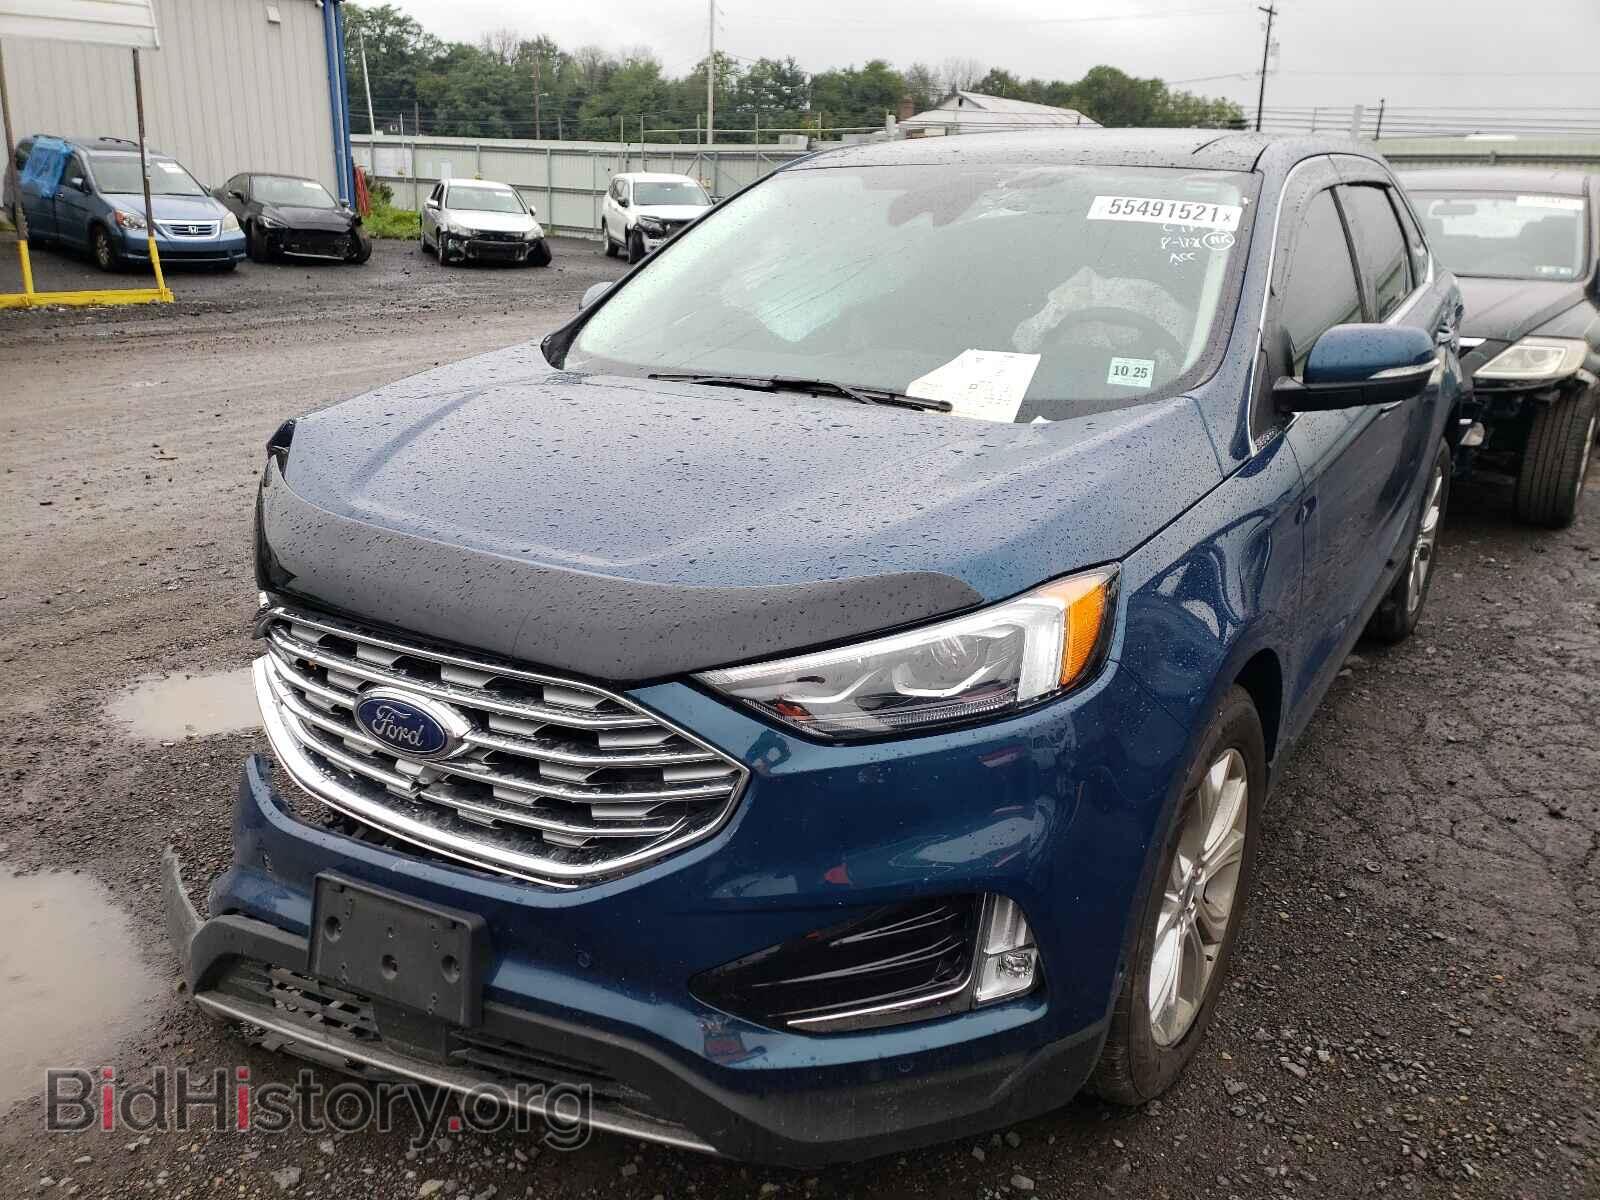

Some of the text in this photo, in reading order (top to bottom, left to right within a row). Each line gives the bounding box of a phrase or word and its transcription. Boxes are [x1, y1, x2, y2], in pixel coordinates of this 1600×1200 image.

[1108, 198, 1219, 222] 55491521
[1113, 365, 1149, 379] 10 25
[372, 705, 424, 746] Ford
